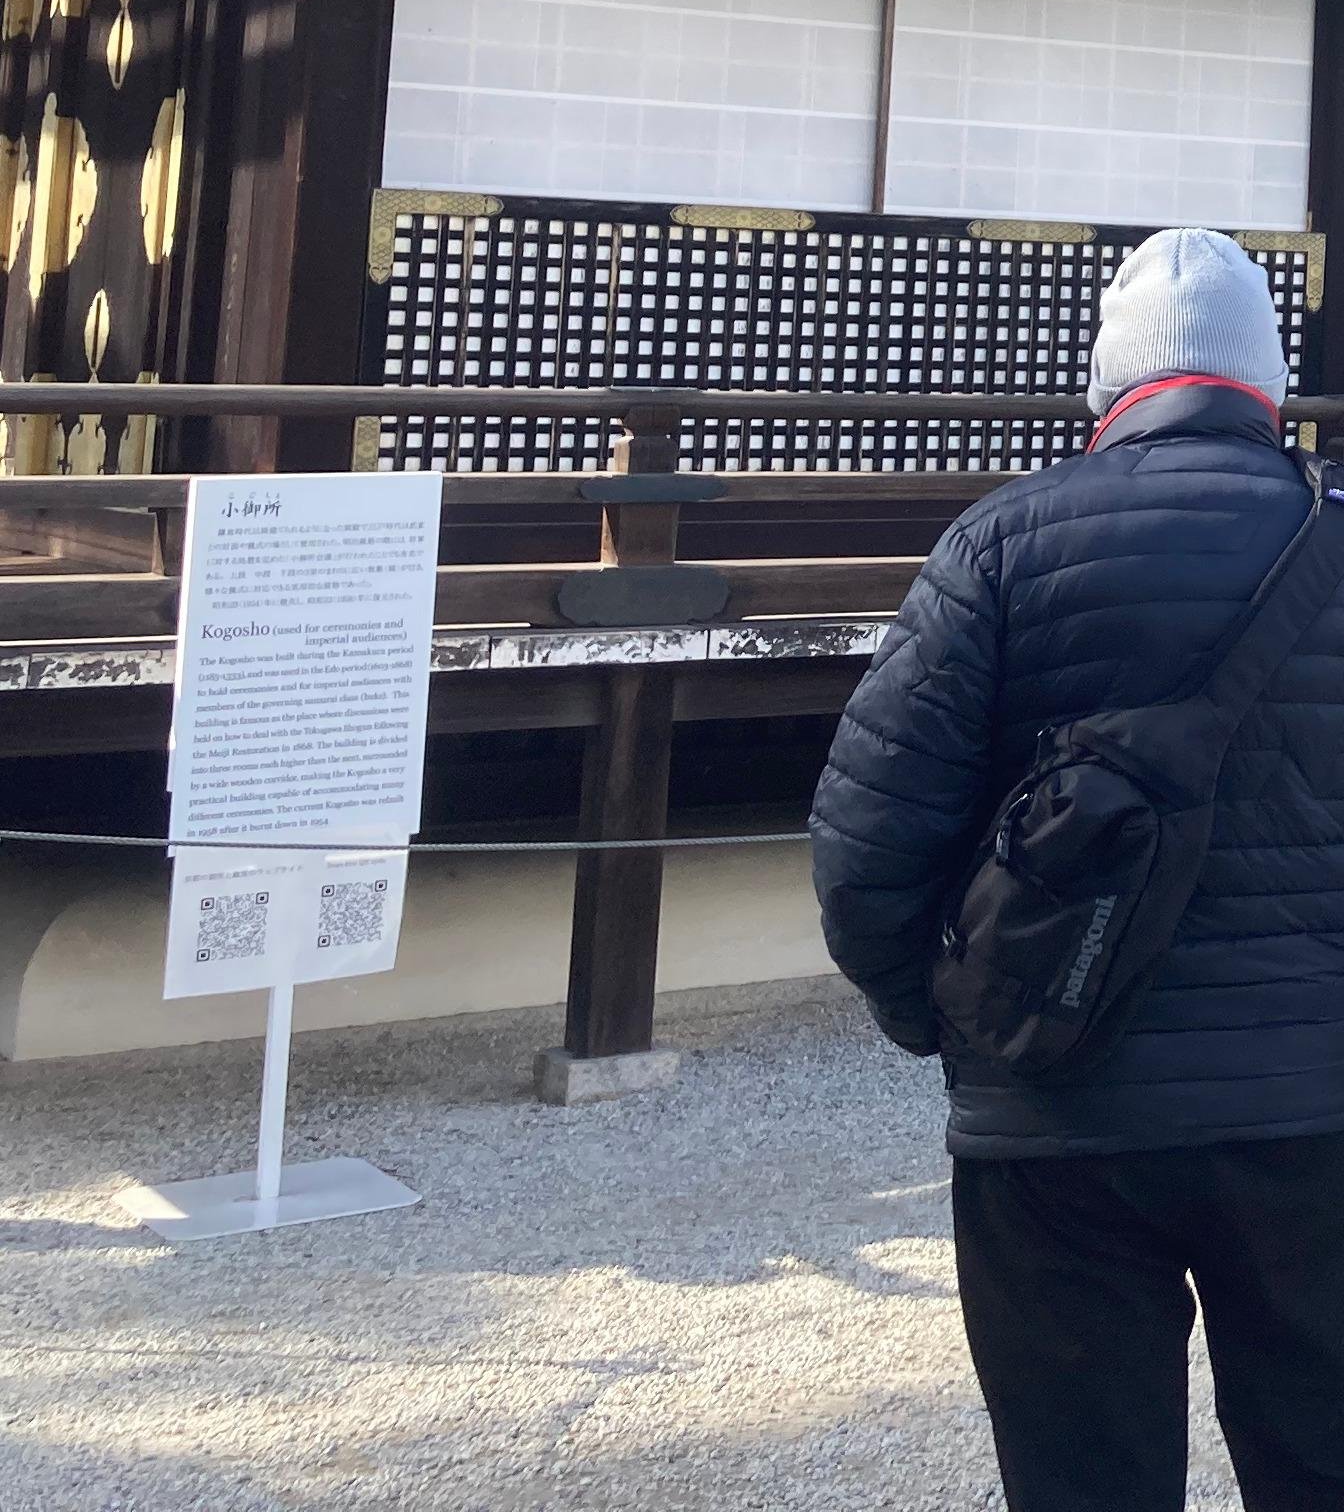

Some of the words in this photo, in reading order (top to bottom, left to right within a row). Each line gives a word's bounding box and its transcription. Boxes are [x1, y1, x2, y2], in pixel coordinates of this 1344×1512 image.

[221, 500, 282, 518] 小御所
[201, 621, 270, 641] Kogosho
[272, 623, 302, 636] (used
[305, 623, 320, 633] for
[322, 620, 381, 632] ceremonies
[384, 618, 404, 628] and
[305, 633, 349, 647] imperial
[200, 656, 216, 666] The
[275, 652, 295, 661] built
[1060, 894, 1118, 1009] patagoni
